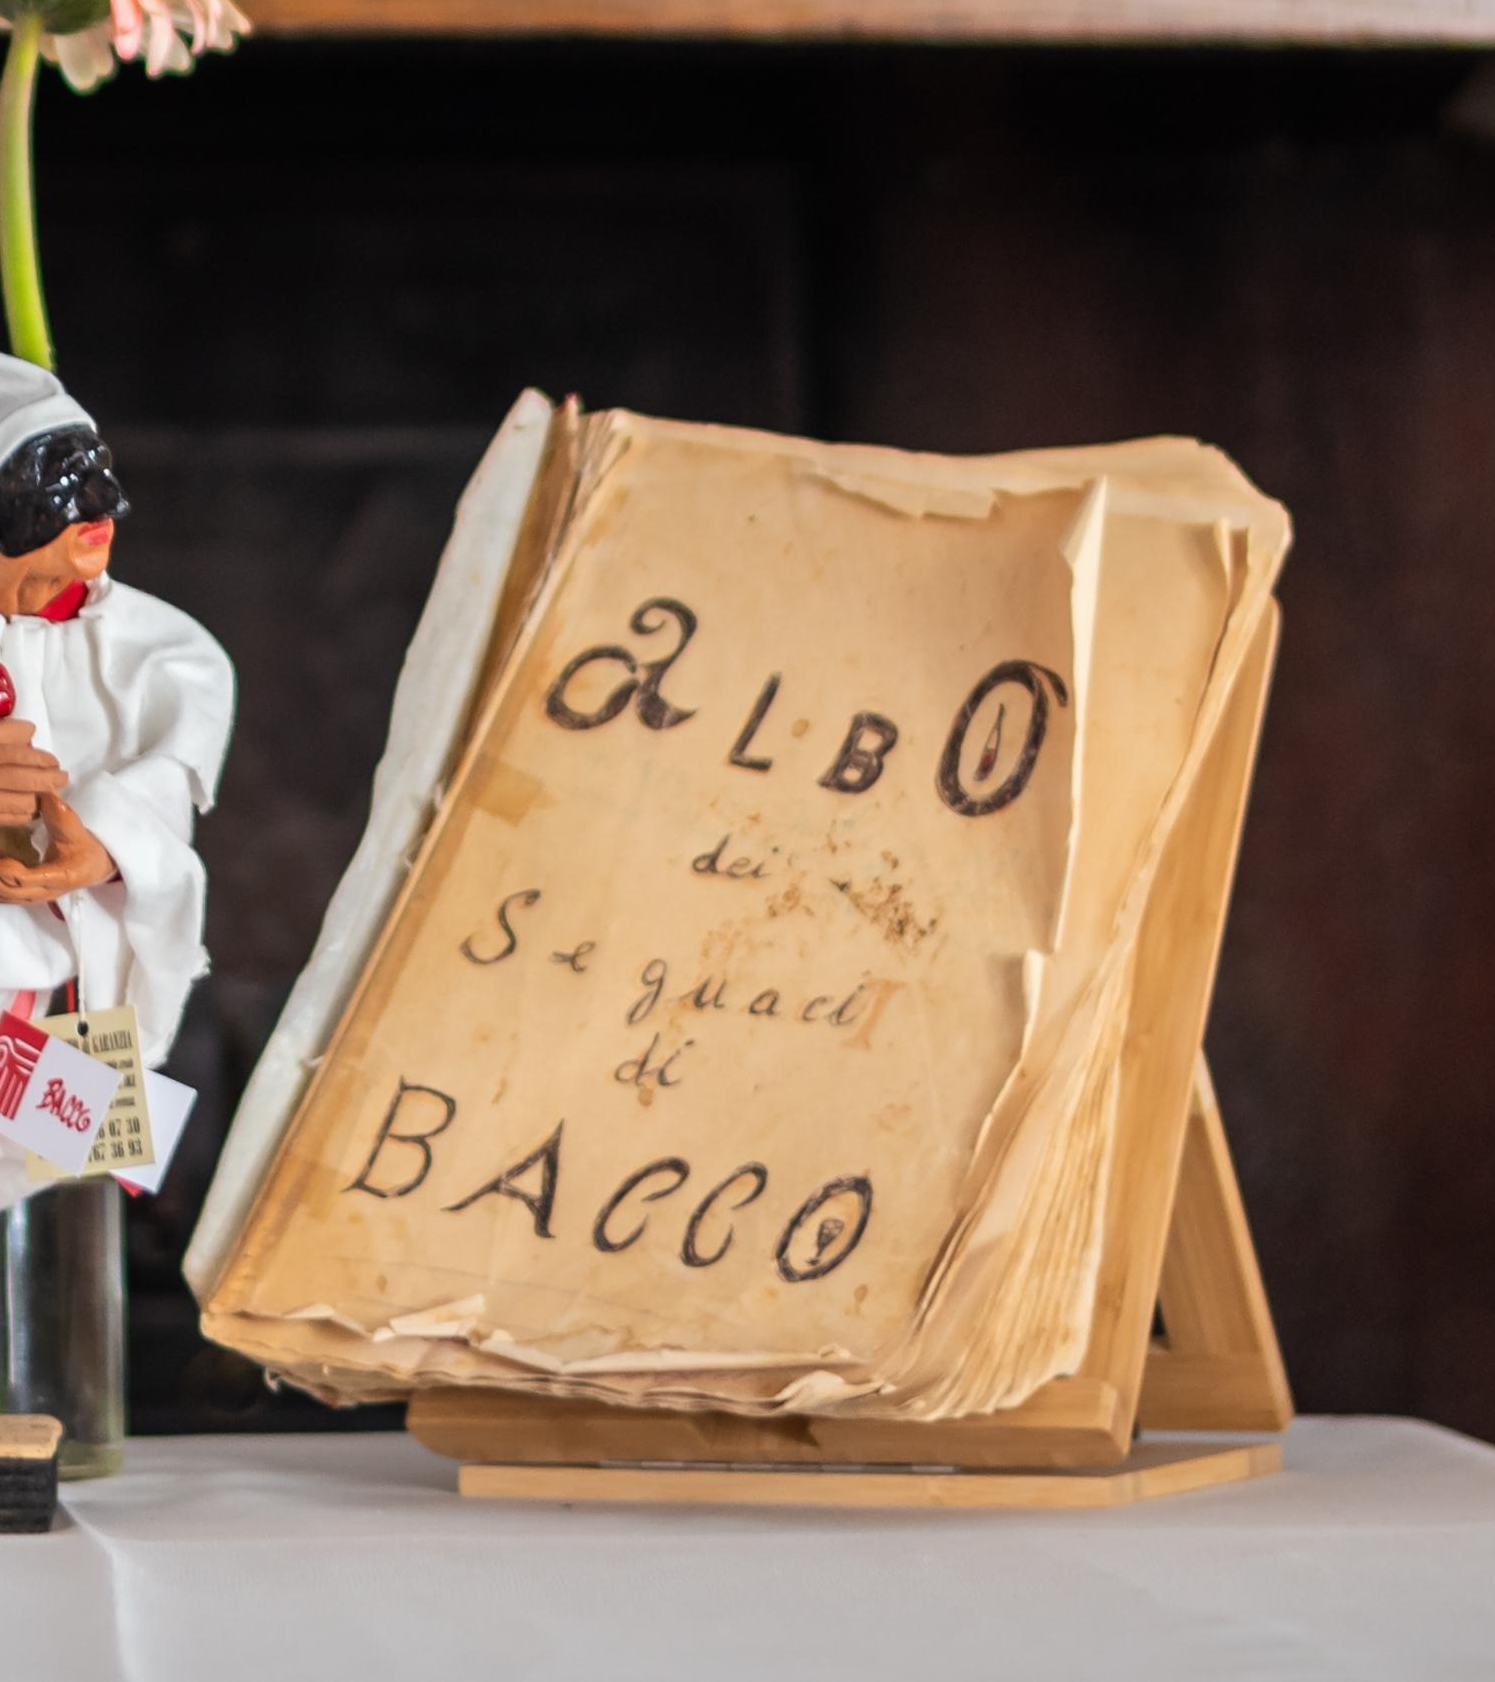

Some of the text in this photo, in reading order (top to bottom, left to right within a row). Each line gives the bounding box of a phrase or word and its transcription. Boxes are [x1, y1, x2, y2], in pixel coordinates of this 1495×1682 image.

[691, 833, 780, 880] dei
[459, 887, 872, 1026] Seguaci
[613, 1031, 696, 1088] di
[341, 1074, 874, 1284] BACCO
